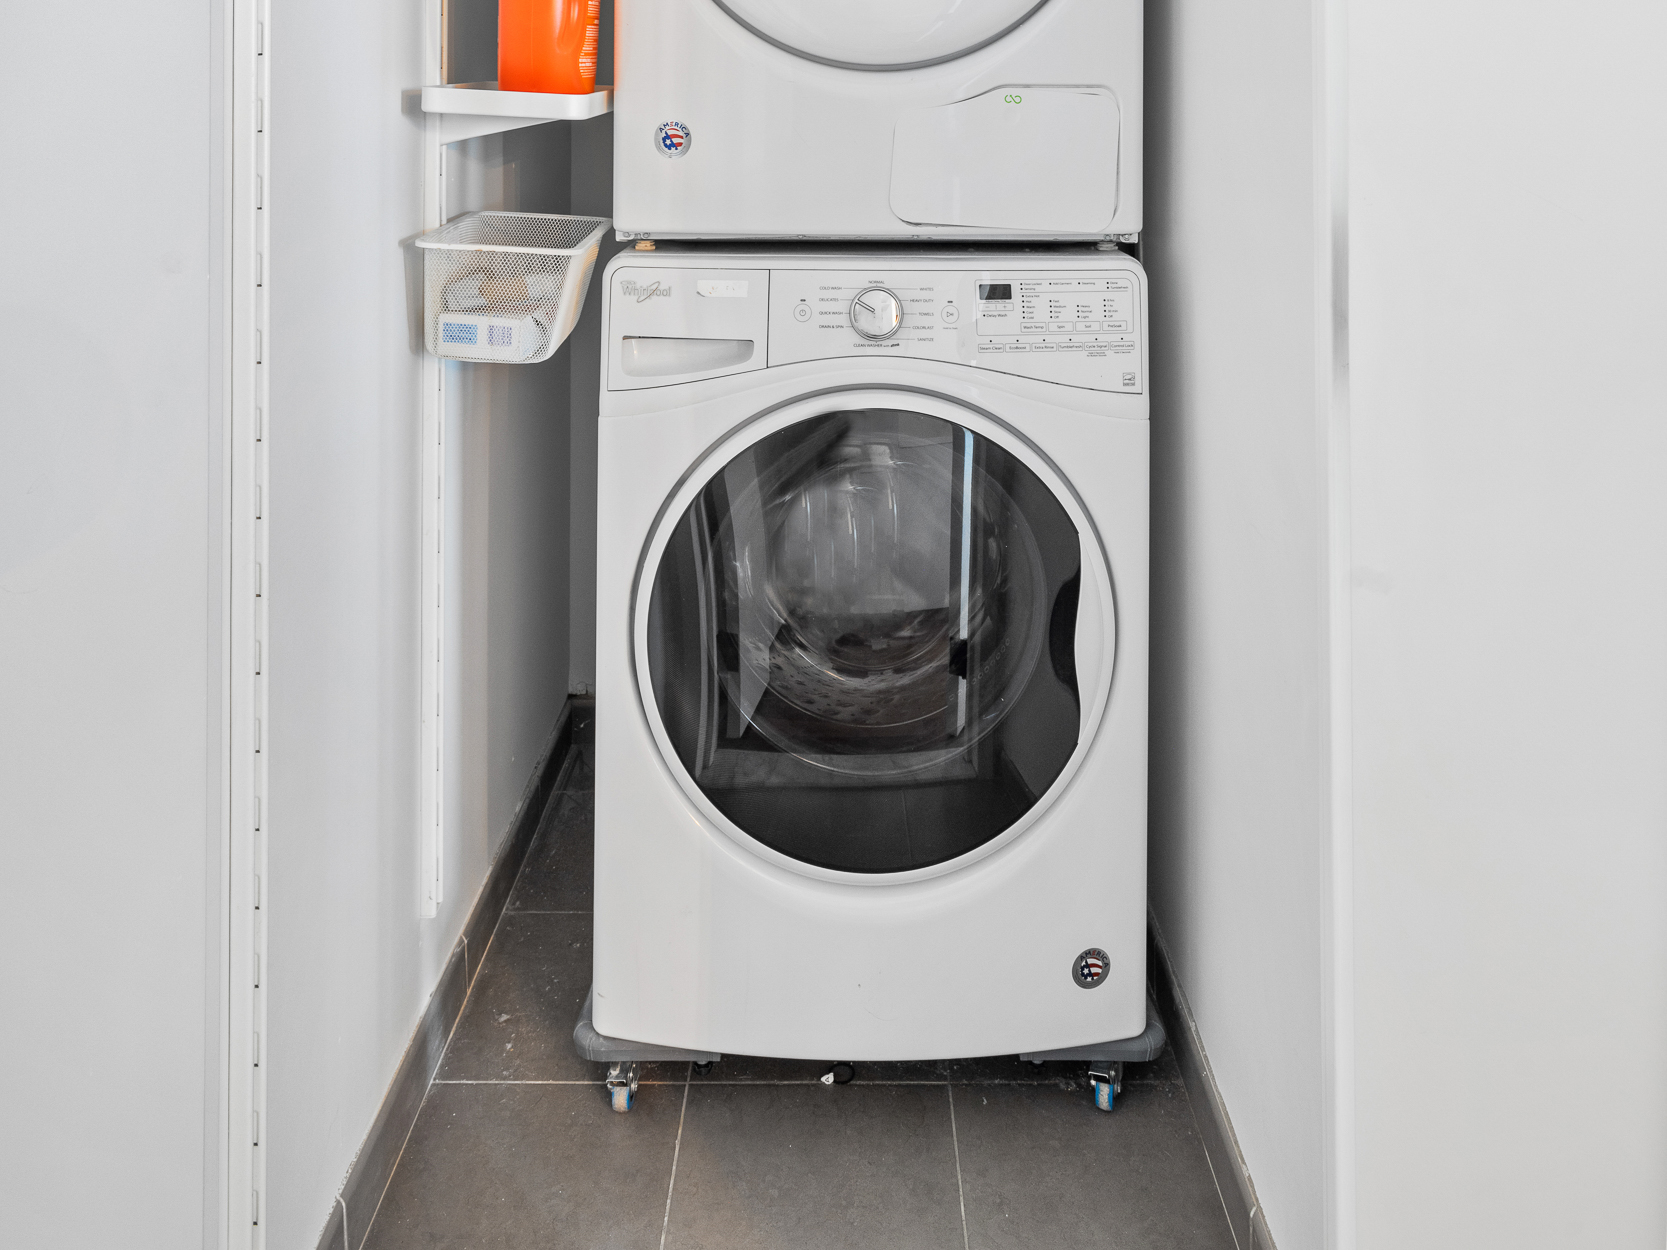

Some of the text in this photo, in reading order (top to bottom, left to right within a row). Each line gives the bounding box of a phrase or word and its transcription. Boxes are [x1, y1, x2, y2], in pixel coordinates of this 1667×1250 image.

[658, 121, 690, 138] AMERICA
[621, 285, 672, 300] Whirlpool
[1080, 950, 1109, 968] AMERICA
